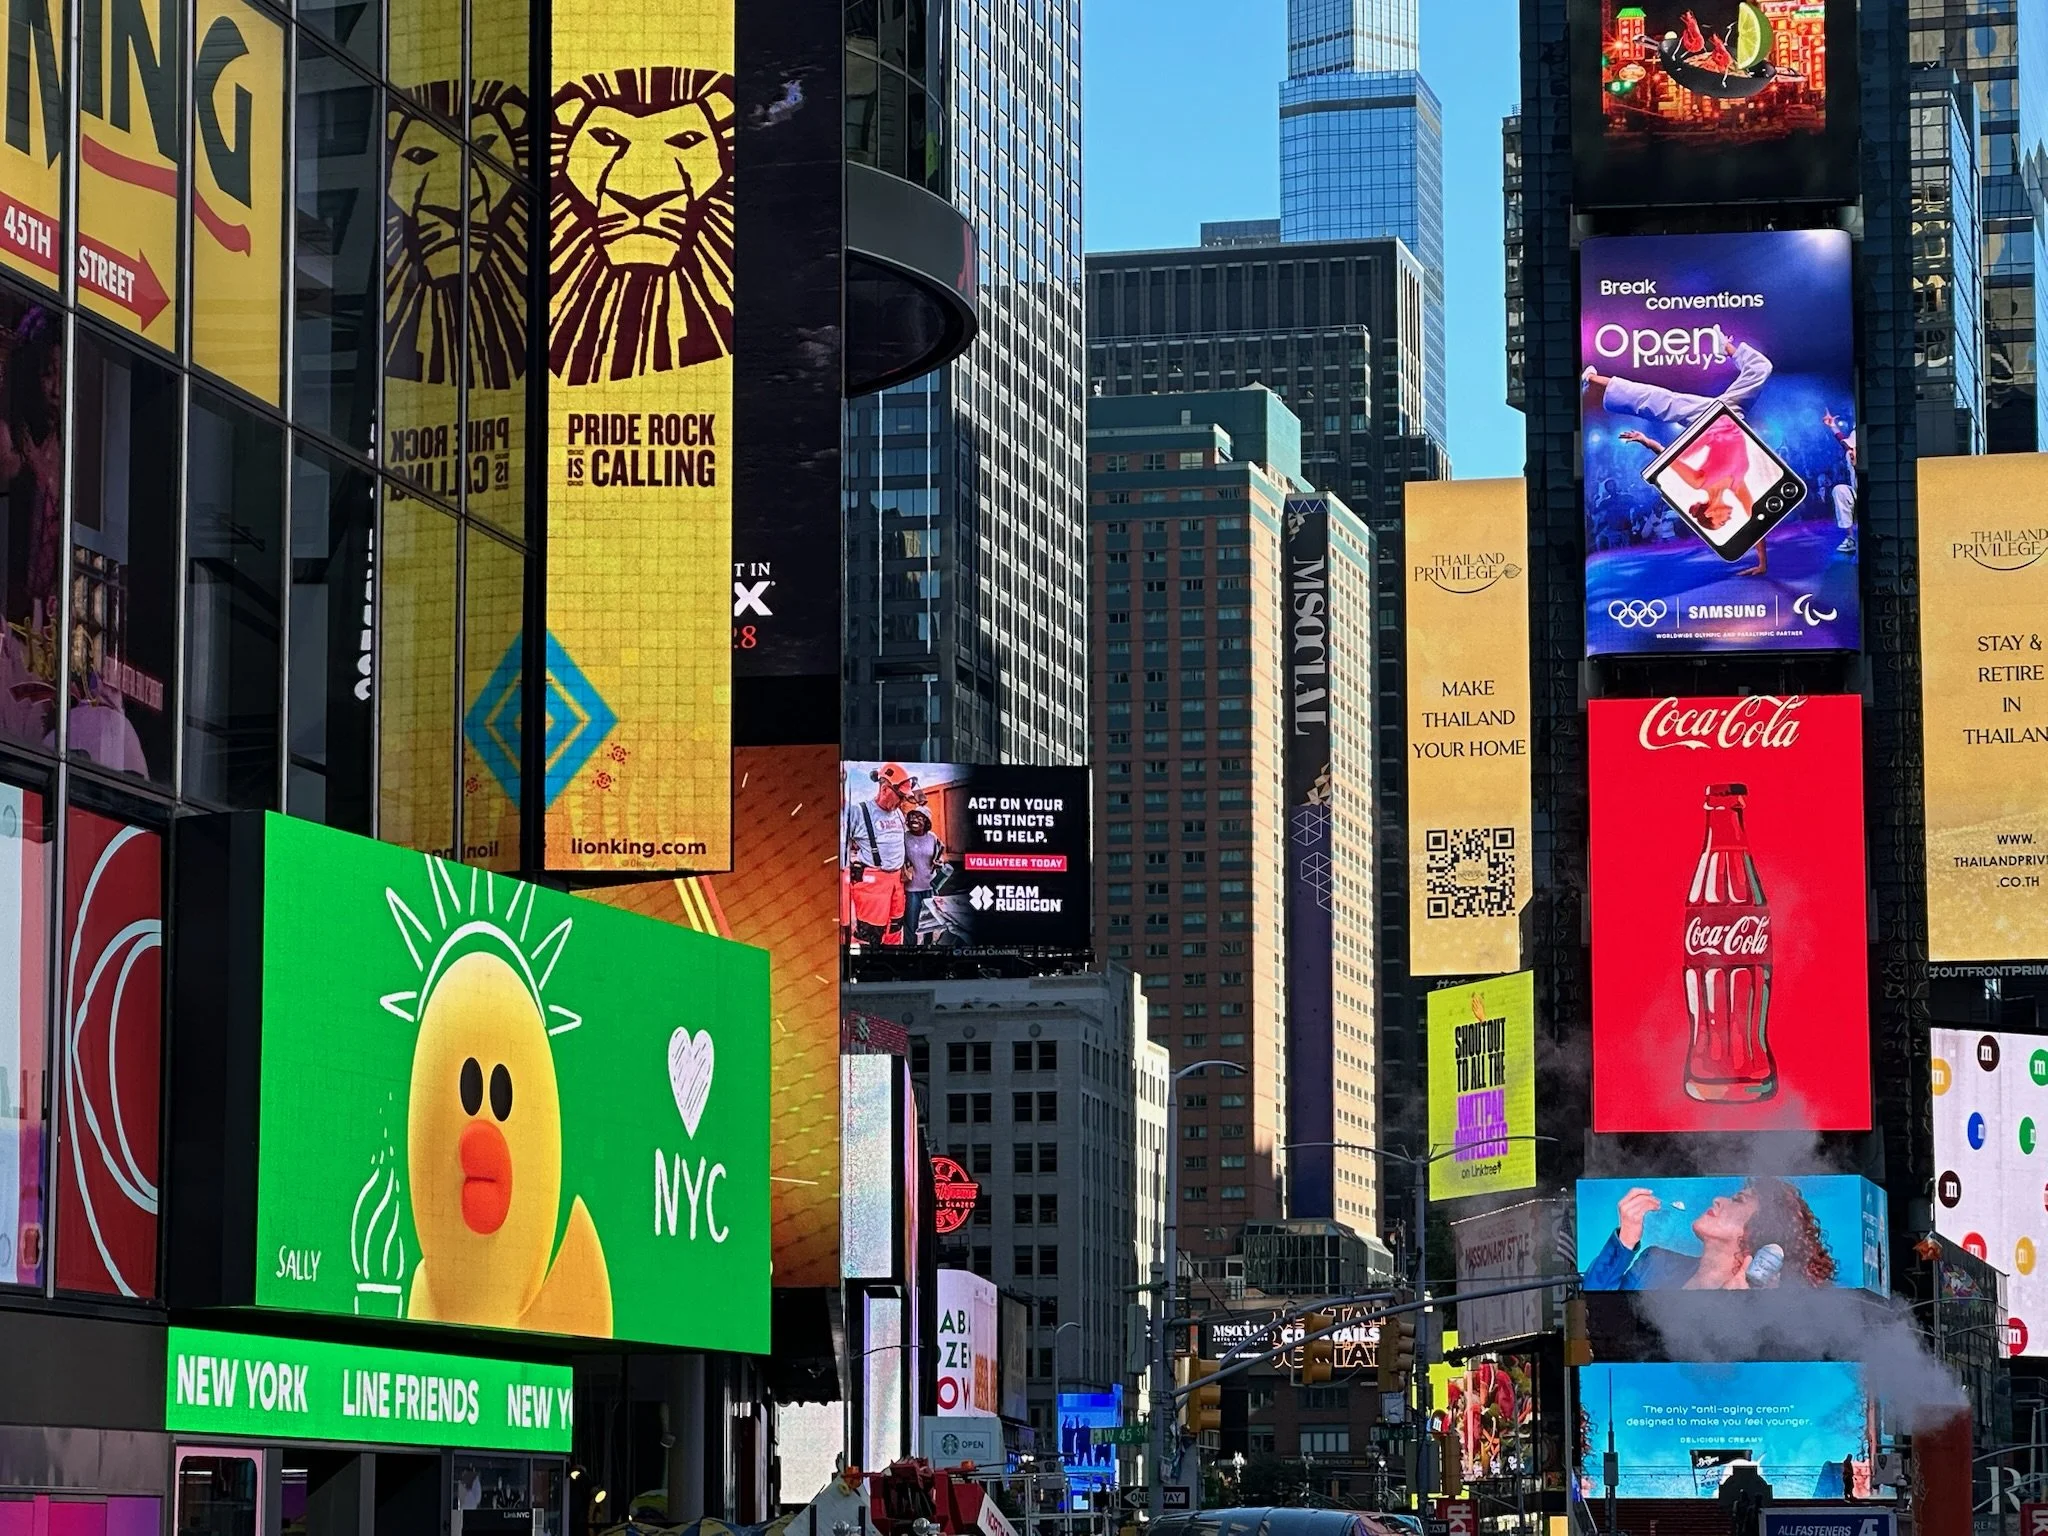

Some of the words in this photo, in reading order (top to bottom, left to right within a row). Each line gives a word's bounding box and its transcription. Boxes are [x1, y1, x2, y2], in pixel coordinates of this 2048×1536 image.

[4, 205, 51, 258] 45TH
[79, 246, 135, 302] STREET
[1601, 279, 1656, 295] Break
[1645, 292, 1764, 310] conventions
[1595, 323, 1720, 368] Open
[568, 413, 641, 445] PRIDE
[648, 413, 715, 446] ROCK
[568, 458, 583, 479] IS
[592, 449, 715, 487] CALLING
[1971, 528, 2048, 543] THAILAND
[1952, 541, 2041, 558] PRIVILEGE
[1432, 552, 1505, 567] THAILAND
[750, 562, 771, 576] IN
[1414, 565, 1497, 582] PRIVILEGE
[1688, 604, 1767, 620] SAMSUNG
[1694, 631, 1722, 639] OLYMPIC
[1737, 630, 1775, 638] PARALYMPIC
[1978, 635, 2025, 652] STAY
[2030, 633, 2042, 651] &
[1978, 665, 2045, 683] RETIRE
[1442, 680, 1495, 697] MAKE
[2003, 697, 2022, 713] IN
[1422, 710, 1515, 728] THAILAND
[1639, 695, 1808, 750] Coca-Cola
[1412, 742, 1465, 758] YOUR
[1470, 740, 1526, 757] HOME
[968, 797, 996, 810] ACT
[1000, 798, 1020, 810] ON
[1024, 799, 1063, 811] YOUR
[977, 814, 1054, 827] INSTINCTS
[984, 830, 1003, 842] TO
[1007, 830, 1048, 843] HELP.
[1997, 834, 2037, 845] WWW.
[571, 838, 707, 859] lionking.com
[969, 858, 1028, 868] VOLUNTEER
[1030, 858, 1063, 868] TODAY
[1996, 876, 2040, 888] .CO.TH
[996, 886, 1039, 899] TEAM
[996, 899, 1062, 913] RUBICON
[1685, 915, 1771, 956] Coca-Cola
[1456, 1058, 1469, 1093] TO
[1471, 1054, 1486, 1090] ALL
[1488, 1051, 1506, 1087] THE
[653, 1148, 729, 1244] NYC
[276, 1245, 322, 1282] SALLY
[176, 1354, 239, 1408] NEW
[244, 1359, 309, 1413] YORK
[342, 1369, 391, 1419] LINE
[395, 1373, 480, 1425] FRIENDS
[507, 1383, 553, 1429] NEW
[557, 1387, 573, 1430] Y
[1643, 1405, 1663, 1414] The
[1666, 1405, 1688, 1415] only
[1626, 1417, 1674, 1428] designed
[1676, 1418, 1687, 1426] to
[1690, 1417, 1720, 1426] make
[1722, 1419, 1741, 1428] you
[1744, 1417, 1764, 1426] feel
[1766, 1418, 1813, 1428] younger.
[1104, 1430, 1115, 1442] W
[1119, 1428, 1132, 1441] 45
[961, 1440, 984, 1449] OPEN
[1778, 1525, 1852, 1536] ALLFASTENERS
